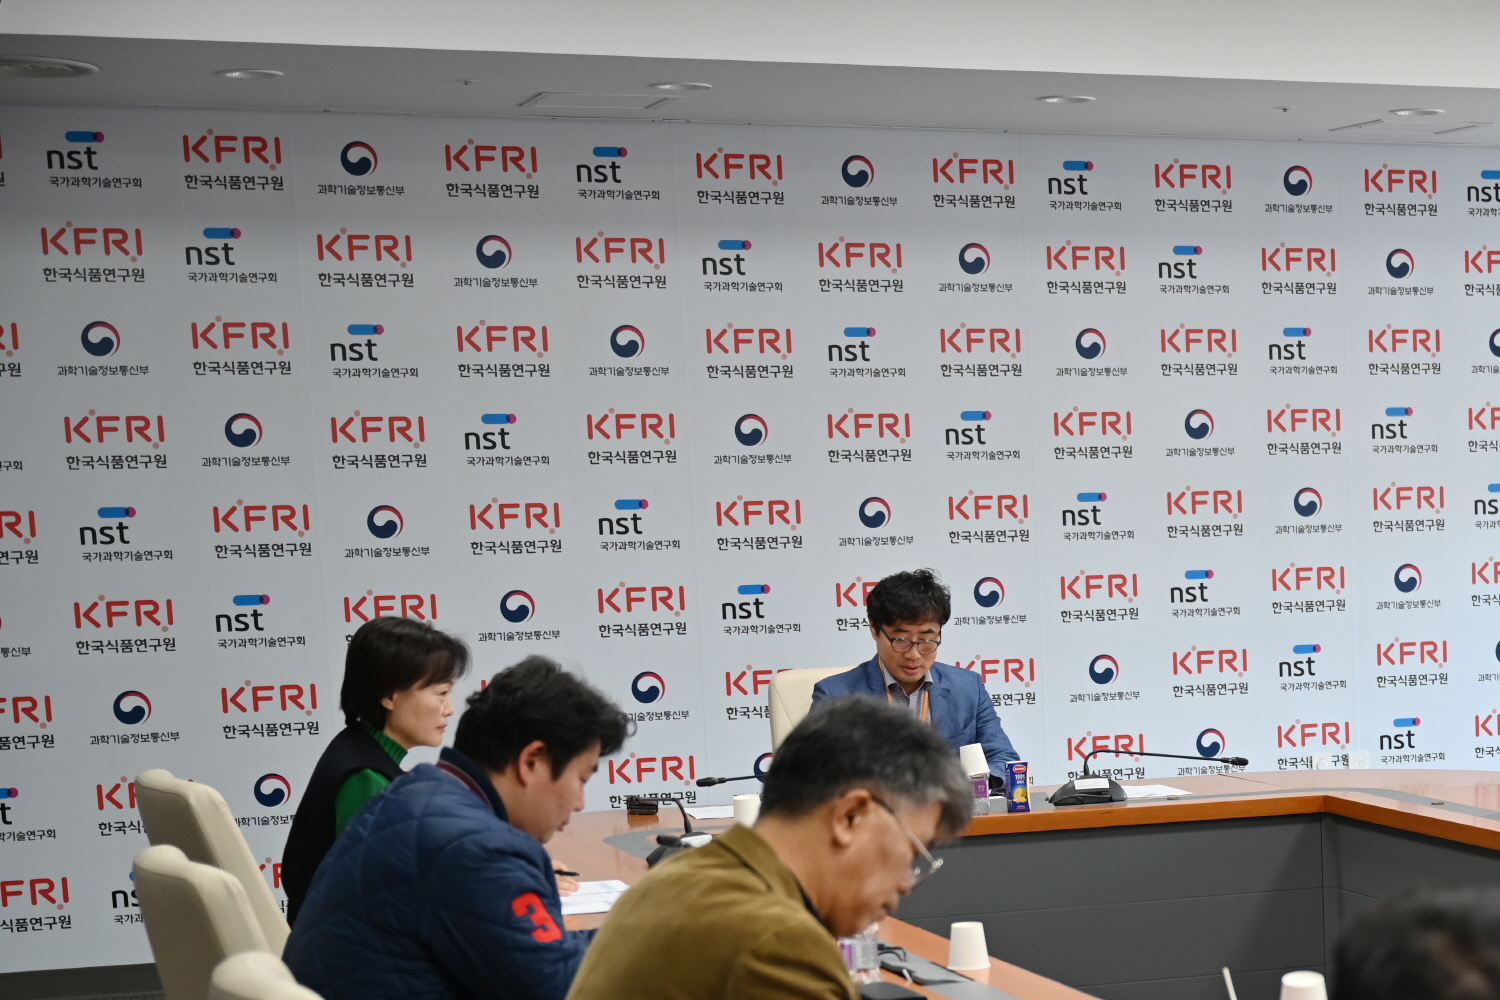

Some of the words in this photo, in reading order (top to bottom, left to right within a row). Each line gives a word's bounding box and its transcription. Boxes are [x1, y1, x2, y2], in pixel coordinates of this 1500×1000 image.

[184, 136, 281, 163] KFRI
[47, 147, 98, 170] nst
[446, 146, 537, 172] KFRI
[577, 161, 621, 183] nst
[934, 159, 1014, 184] KFRI
[50, 177, 141, 188] 국가과학기술연구회
[184, 175, 283, 190] 한국식품연구원
[1365, 170, 1436, 193] KFRI
[318, 185, 404, 196] 과학기술정보통신부
[446, 183, 539, 198] 한국식품연구원
[578, 190, 659, 200] 국가과학기술연구회
[821, 196, 897, 206] 과학기술정보통신부
[933, 194, 1015, 208] 한국식품연구원
[1364, 203, 1437, 216] 한국식품연구원
[42, 228, 142, 255] KFRI
[186, 243, 235, 265] nst
[577, 238, 664, 263] KFRI
[819, 243, 901, 268] KFRI
[1047, 246, 1125, 270] KFRI
[702, 254, 745, 275] nst
[1159, 259, 1197, 279] nst
[43, 268, 145, 282] 한국식품연구원
[188, 272, 277, 283] 국가과학기술연구회
[454, 277, 537, 288] 과학기술정보통신부
[577, 275, 666, 288] 한국식품연구원
[704, 282, 782, 292] 국가과학기술연구회
[819, 279, 903, 292] 한국식품연구원
[939, 283, 1012, 292] 과학기술정보통신부
[1047, 281, 1126, 294] 한국식품연구원
[1160, 285, 1229, 294] 국가과학기술연구회
[1262, 282, 1336, 294] 한국식품연구원
[1368, 287, 1433, 296] 과학기술정보통신부
[192, 323, 288, 349] KFRI
[458, 326, 548, 352] KFRI
[707, 329, 791, 354] KFRI
[1162, 329, 1236, 353] KFRI
[1370, 330, 1440, 352] KFRI
[330, 339, 378, 361] nst
[828, 341, 870, 361] nst
[1269, 341, 1306, 360] nst
[58, 366, 149, 376] 과학기술정보통신부
[193, 361, 291, 375] 한국식품연구원
[332, 368, 418, 378] 국가과학기술연구회
[458, 364, 550, 377] 한국식품연구원
[589, 367, 669, 376] 과학기술정보통신부
[707, 365, 793, 378] 한국식품연구원
[830, 368, 905, 377] 국가과학기술연구회
[1056, 368, 1127, 376] 과학기술정보통신부
[1369, 363, 1440, 375] 한국식품연구원
[588, 414, 674, 439] KFRI
[1054, 412, 1131, 435] KFRI
[1268, 409, 1340, 432] KFRI
[65, 416, 164, 443] KFRI
[332, 417, 424, 443] KFRI
[946, 425, 986, 445] nst
[1372, 420, 1407, 439] nst
[828, 449, 911, 463] 한국식품연구원
[947, 451, 1020, 460] 국가과학기술연구회
[1054, 446, 1132, 459] 한국식품연구원
[1166, 447, 1234, 456] 과학기술정보통신부
[1373, 444, 1437, 454] 국가과학기술연구회
[202, 456, 290, 467] 과학기술정보통신부
[332, 454, 427, 469] 한국식품연구원
[588, 450, 676, 464] 한국식품연구원
[1374, 487, 1444, 510] KFRI
[950, 495, 1028, 519] KFRI
[214, 505, 309, 531] KFRI
[470, 503, 560, 529] KFRI
[599, 514, 642, 535] nst
[1167, 524, 1243, 538] 한국식품연구원
[1276, 524, 1342, 534] 과학기술정보통신부
[1373, 519, 1444, 532] 한국식품연구원
[80, 522, 130, 545] nst
[839, 536, 913, 546] 과학기술정보통신부
[215, 543, 311, 558] 한국식품연구원
[471, 540, 562, 555] 한국식품연구원
[600, 540, 680, 551] 국가과학기술연구회
[717, 536, 802, 550] 한국식품연구원
[82, 550, 172, 562] 국가과학기술연구회
[345, 547, 430, 558] 과학기술정보통신부
[1061, 575, 1138, 599] KFRI
[599, 587, 684, 612] KFRI
[344, 595, 437, 620] KFRI
[722, 598, 764, 619] nst
[216, 609, 264, 632] nst
[1061, 608, 1138, 623] 한국식품연구원
[479, 630, 560, 642] 과학기술정보통신부
[599, 622, 686, 638] 한국식품연구원
[724, 624, 800, 635] 국가과학기술연구회
[76, 638, 176, 655] 한국식품연구원
[218, 636, 305, 649] 국가과학기술연구회
[1174, 650, 1247, 674] KFRI
[1279, 657, 1315, 677] nst
[1173, 682, 1248, 697] 한국식품연구원
[1281, 680, 1346, 691] 국가과학기술연구회
[222, 685, 317, 711] KFRI
[1070, 691, 1140, 702] 과학기술정보통신부
[223, 721, 319, 739] 한국식품연구원
[90, 732, 180, 745] 과학기술정보통신부
[1380, 730, 1415, 750] nst
[1068, 735, 1144, 758] KFRI
[1381, 753, 1444, 764] 국가과학기술연구회
[511, 892, 562, 943] 3
